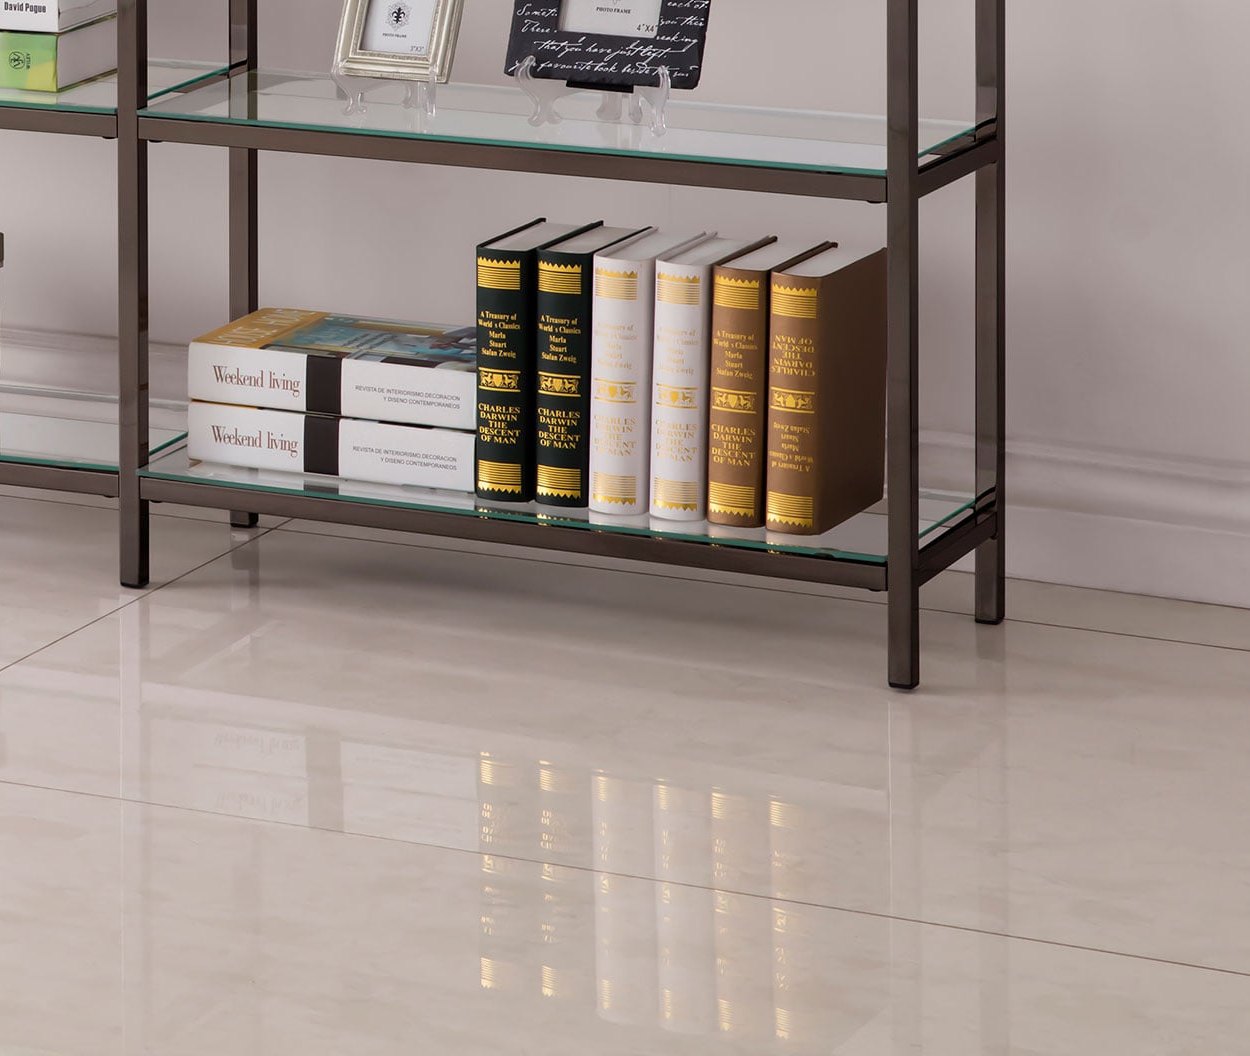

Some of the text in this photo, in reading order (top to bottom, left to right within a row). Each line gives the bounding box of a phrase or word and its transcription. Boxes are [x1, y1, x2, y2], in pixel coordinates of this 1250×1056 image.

[4, 1, 47, 14] David Pogue
[485, 311, 510, 322] Treasury
[546, 315, 570, 326] Treasury
[498, 322, 521, 330] Classics
[559, 326, 581, 334] Classics
[721, 330, 746, 342] Treasury
[775, 335, 813, 345] OF MAN
[489, 340, 507, 348] Stuart
[549, 344, 567, 353] Stuart
[735, 342, 758, 350] Classics
[772, 342, 815, 353] DESCENT
[498, 349, 516, 359] Zweig
[559, 354, 577, 363] Zweig
[781, 351, 801, 359] THE
[725, 360, 743, 368] Stuart
[773, 357, 813, 368] DARWIN
[734, 370, 754, 380] Zweig
[771, 366, 815, 376] CHARLES
[213, 365, 301, 398] Weekend living
[386, 389, 424, 397] INTERIORISMO
[424, 392, 461, 401] DECORACION
[408, 399, 461, 409] CONTEMPORANEOS
[478, 402, 521, 414] CHARLES
[480, 411, 518, 421] DARWIN
[537, 407, 580, 419] CHARLES
[488, 420, 508, 429] THE
[539, 415, 577, 426] DARWIN
[479, 426, 521, 437] DESCENT
[548, 425, 567, 433] THE
[711, 423, 756, 435] CHARLES
[211, 425, 299, 458] Weekend living
[480, 434, 516, 444] OF MAN
[538, 430, 580, 442] DESCENT
[713, 432, 752, 443] DARWIN
[540, 438, 576, 449] OF MAN
[722, 441, 742, 450] THE
[383, 449, 421, 458] INTERIORISMO
[422, 453, 457, 462] DECORACION
[608, 448, 631, 456] MAN
[712, 447, 755, 459] DESCENT
[670, 454, 693, 462] MAN
[713, 455, 750, 466] OF MAN
[406, 460, 457, 471] CONTEMPORANEOS
